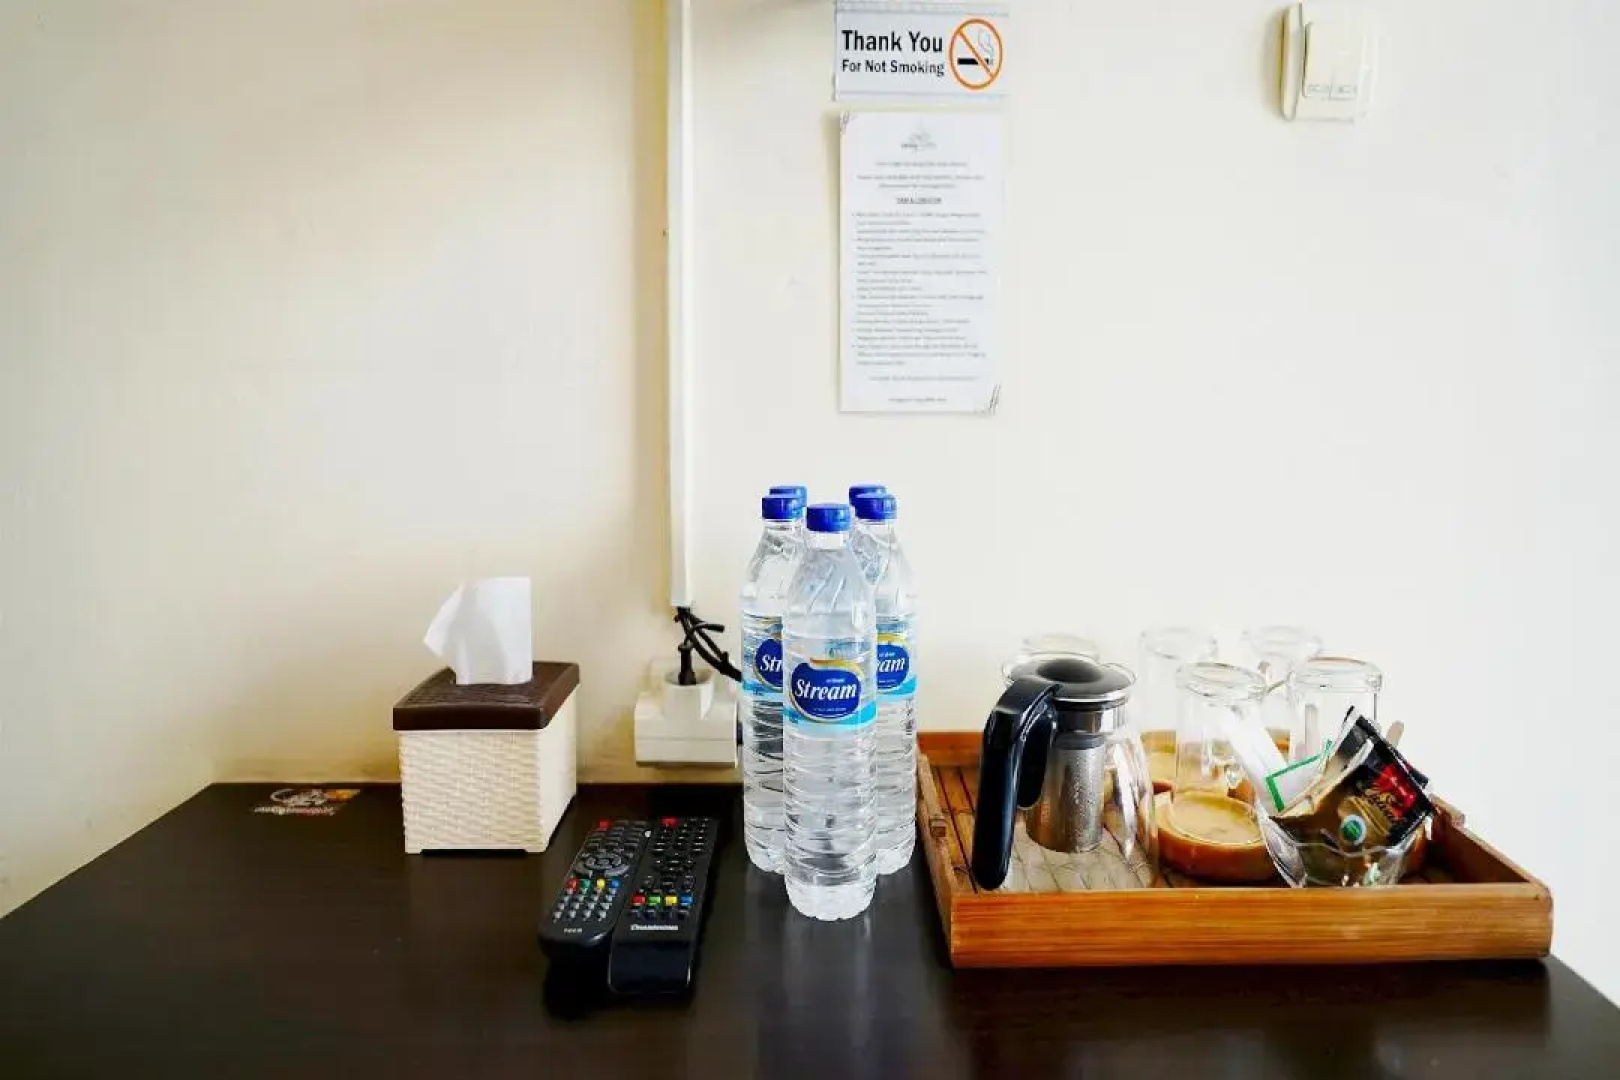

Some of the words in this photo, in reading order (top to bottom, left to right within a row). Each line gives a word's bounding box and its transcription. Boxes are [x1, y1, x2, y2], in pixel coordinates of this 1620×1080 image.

[841, 29, 902, 52] Thank
[908, 31, 943, 52] You
[842, 59, 862, 73] For
[865, 60, 886, 73] Not
[890, 60, 945, 77] Smoking
[760, 653, 783, 672] Str
[795, 679, 857, 700] Stream
